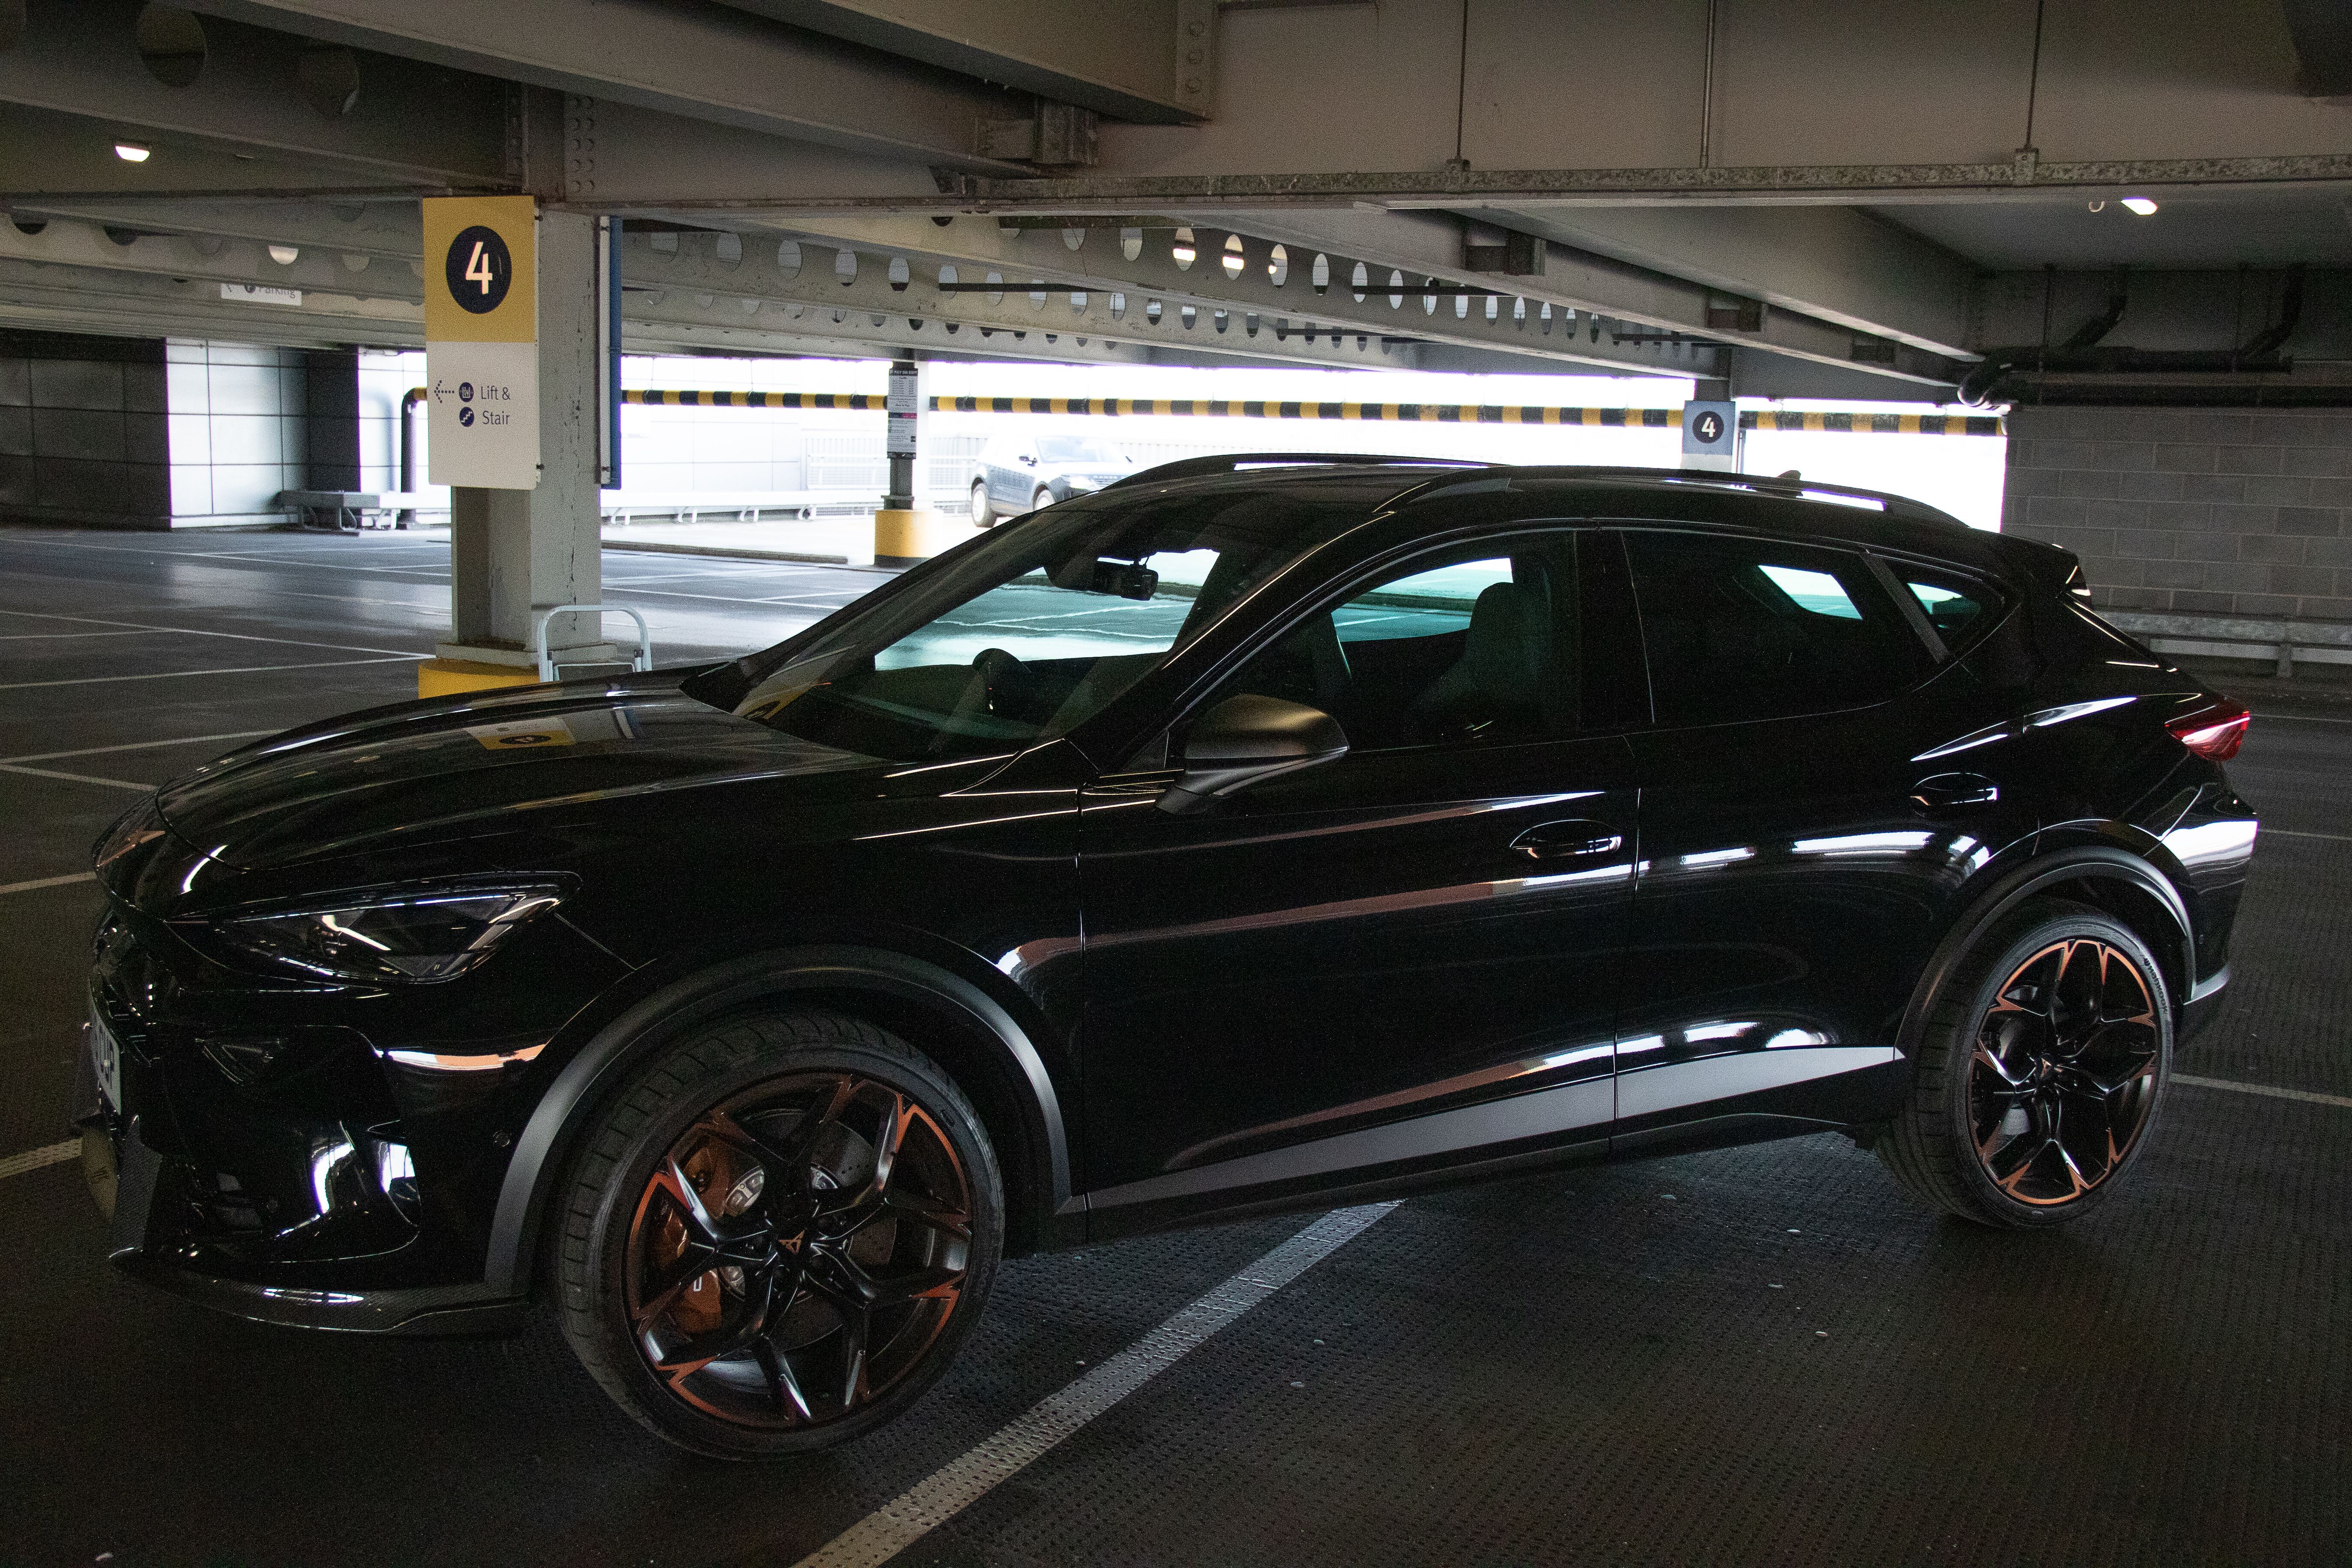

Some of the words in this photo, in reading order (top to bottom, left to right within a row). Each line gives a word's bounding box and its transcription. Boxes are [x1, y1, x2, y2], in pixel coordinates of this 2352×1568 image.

[466, 241, 493, 295] 4
[481, 385, 499, 400] Lift
[502, 387, 511, 400] &
[482, 410, 510, 425] Stair
[1701, 416, 1716, 438] 4
